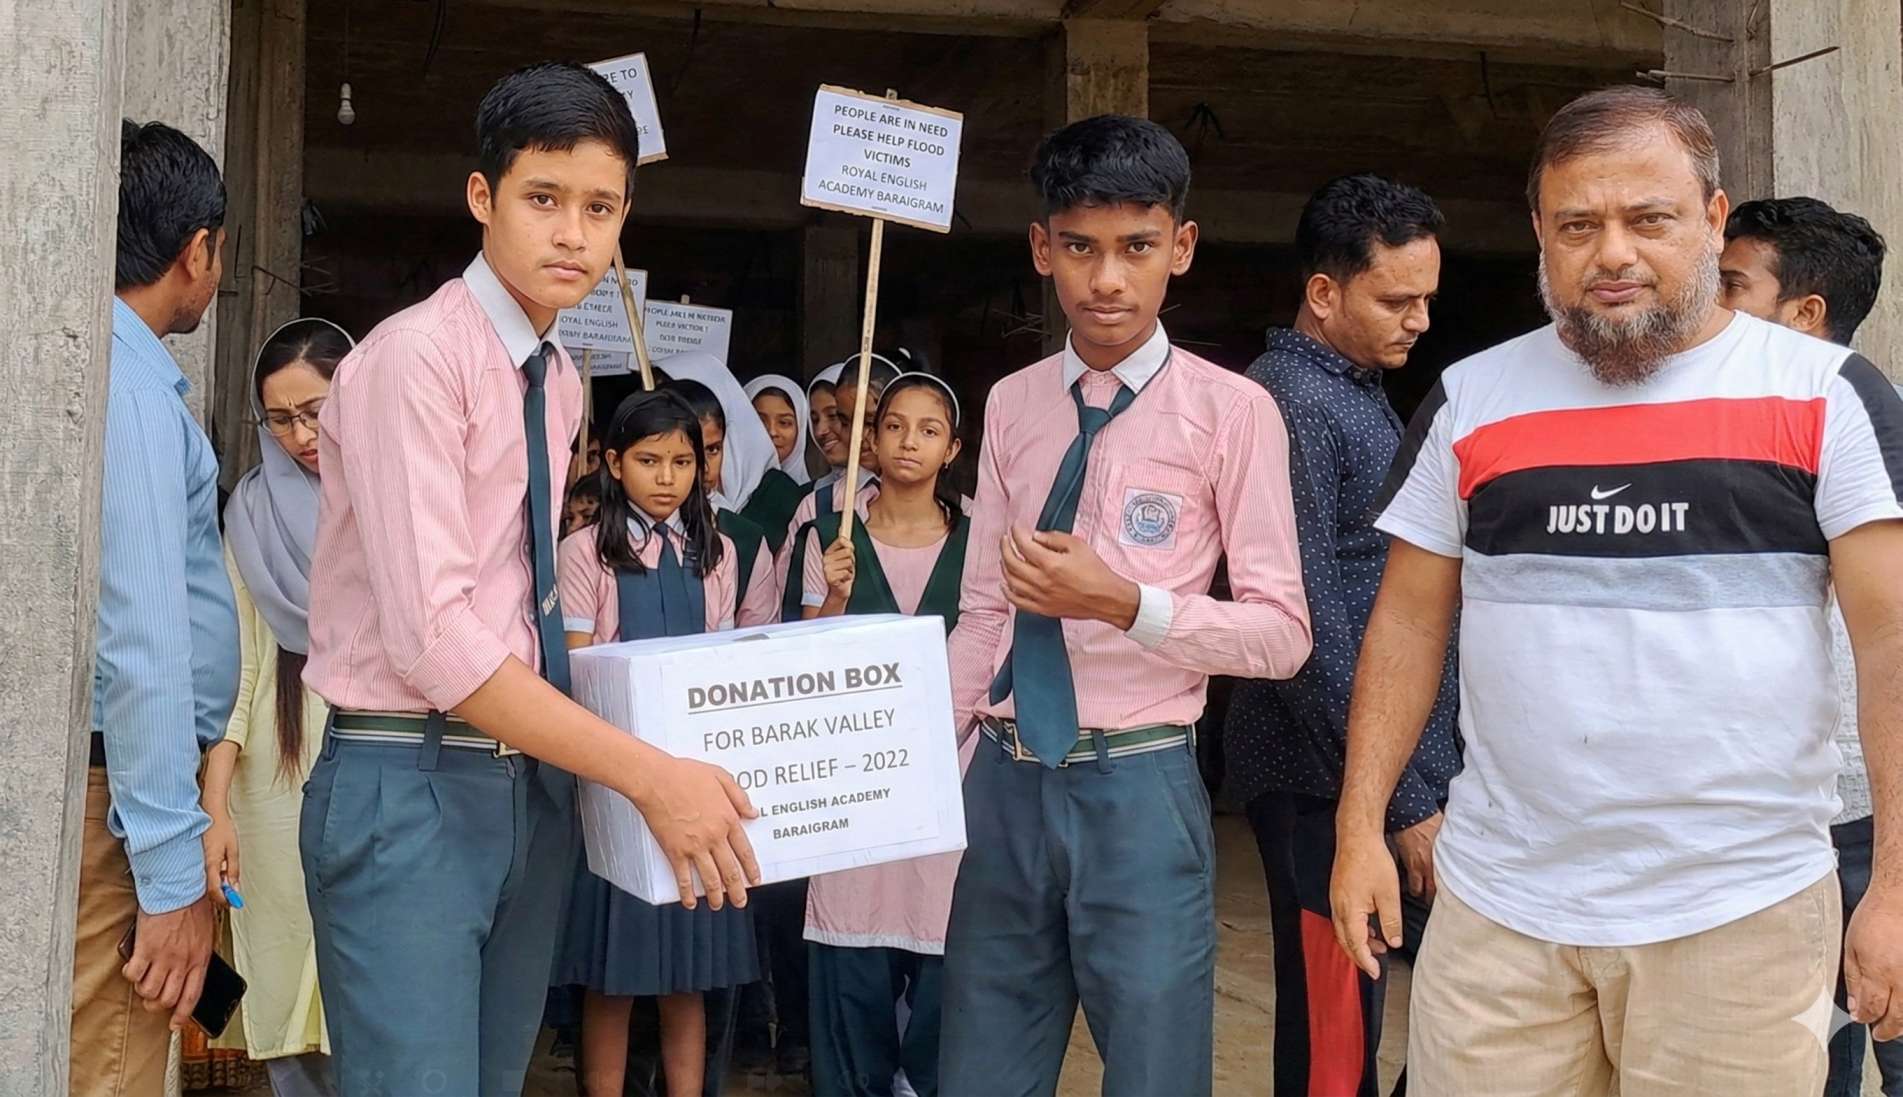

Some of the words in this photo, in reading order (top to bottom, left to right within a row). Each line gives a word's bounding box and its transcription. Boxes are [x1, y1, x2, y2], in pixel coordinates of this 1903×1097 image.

[620, 68, 637, 80] TO
[834, 105, 877, 122] PEOPLE
[879, 114, 901, 127] ARE
[904, 119, 916, 130] IN
[918, 122, 948, 138] NEED
[833, 124, 874, 141] PLEASE
[876, 133, 905, 147] HELP
[907, 139, 945, 156] FLOOD
[864, 149, 911, 168] VICTIMS
[841, 165, 878, 181] ROYAL
[880, 172, 927, 191] ENGLISH
[818, 180, 875, 200] ACADEMY
[876, 191, 944, 214] BARAIGRAM
[560, 316, 583, 325] OYAL
[1546, 505, 1609, 534] JUST
[1614, 503, 1656, 534] DO
[1661, 502, 1689, 532] IT
[688, 670, 836, 709] DONATION
[845, 662, 902, 689] BOX
[703, 729, 745, 752] FOR
[752, 718, 820, 746] BARAK
[824, 708, 895, 735] VALLEY
[775, 758, 838, 785] RELIEF
[862, 748, 910, 772] 2022
[772, 798, 827, 816] ENGLISH
[831, 788, 891, 806] ACADEMY
[773, 818, 850, 840] BARAIGRAM
